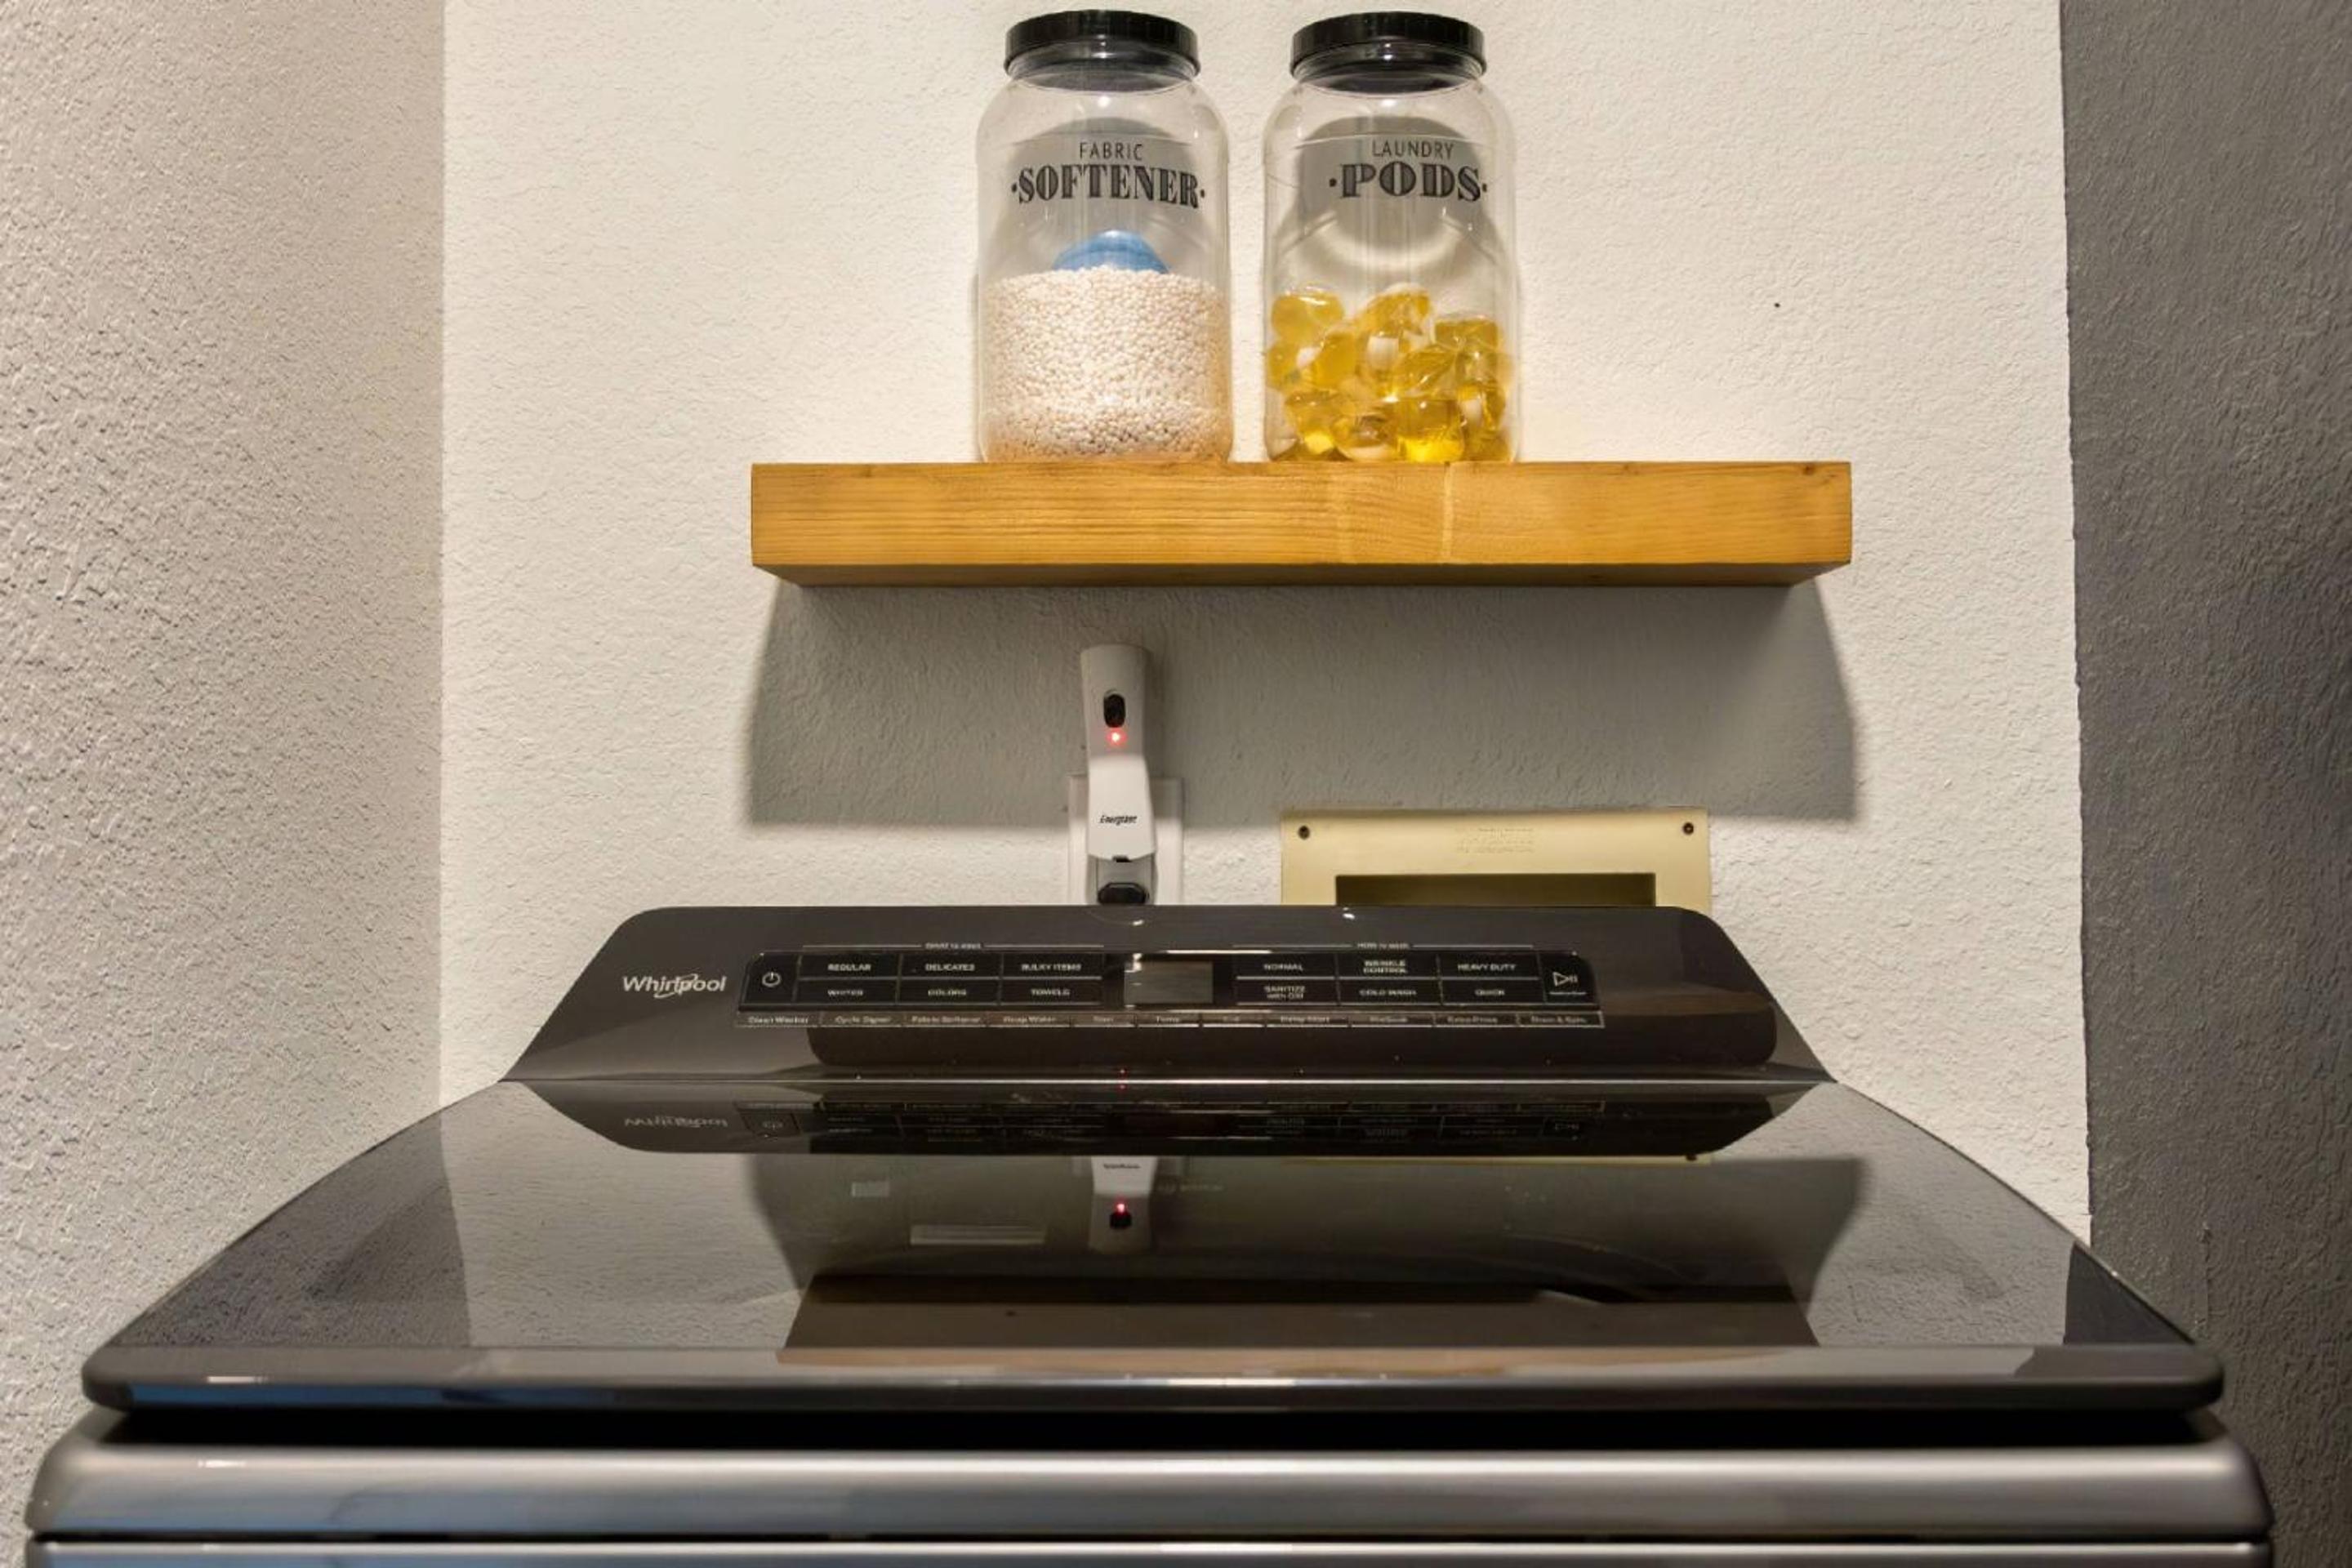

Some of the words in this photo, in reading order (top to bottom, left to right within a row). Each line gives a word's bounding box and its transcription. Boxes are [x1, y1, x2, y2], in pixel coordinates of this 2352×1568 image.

[1079, 141, 1144, 161] FABRIC
[1371, 139, 1454, 159] LAUNDRY
[827, 963, 871, 971] REGULAR
[924, 964, 975, 972] DELICATES
[622, 973, 728, 1000] Whirlpool
[1031, 988, 1071, 996] TOWELS
